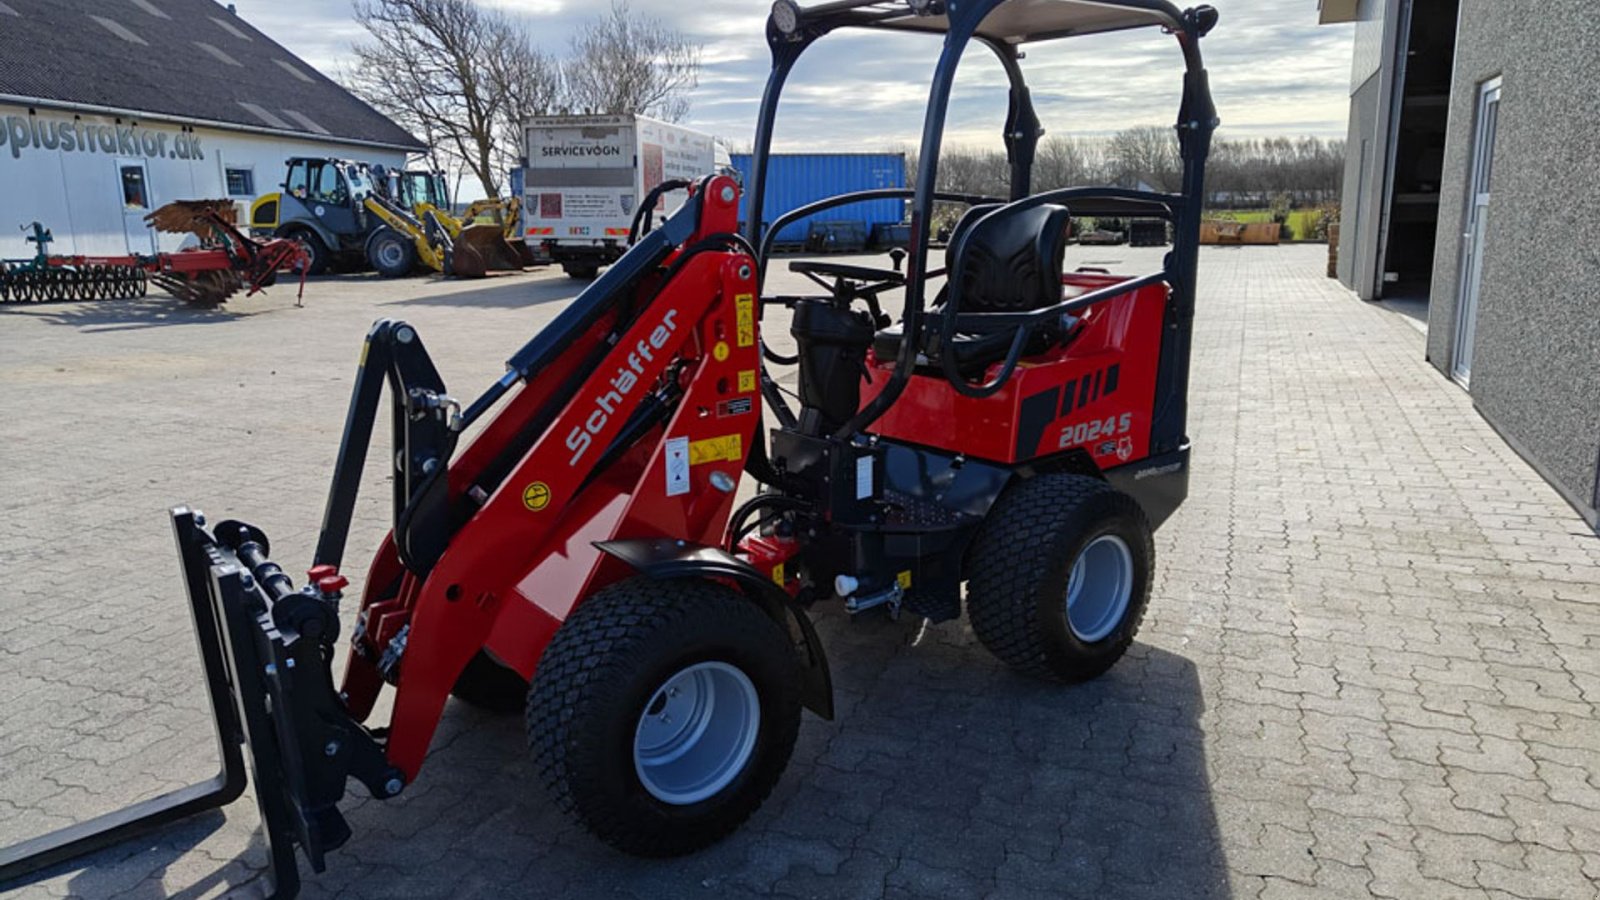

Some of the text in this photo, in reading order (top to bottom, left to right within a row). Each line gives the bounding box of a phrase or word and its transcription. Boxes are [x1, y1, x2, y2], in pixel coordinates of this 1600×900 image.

[542, 146, 620, 156] SERVICEVOGN
[565, 309, 678, 466] Schäffer
[1059, 416, 1116, 448] 2024
